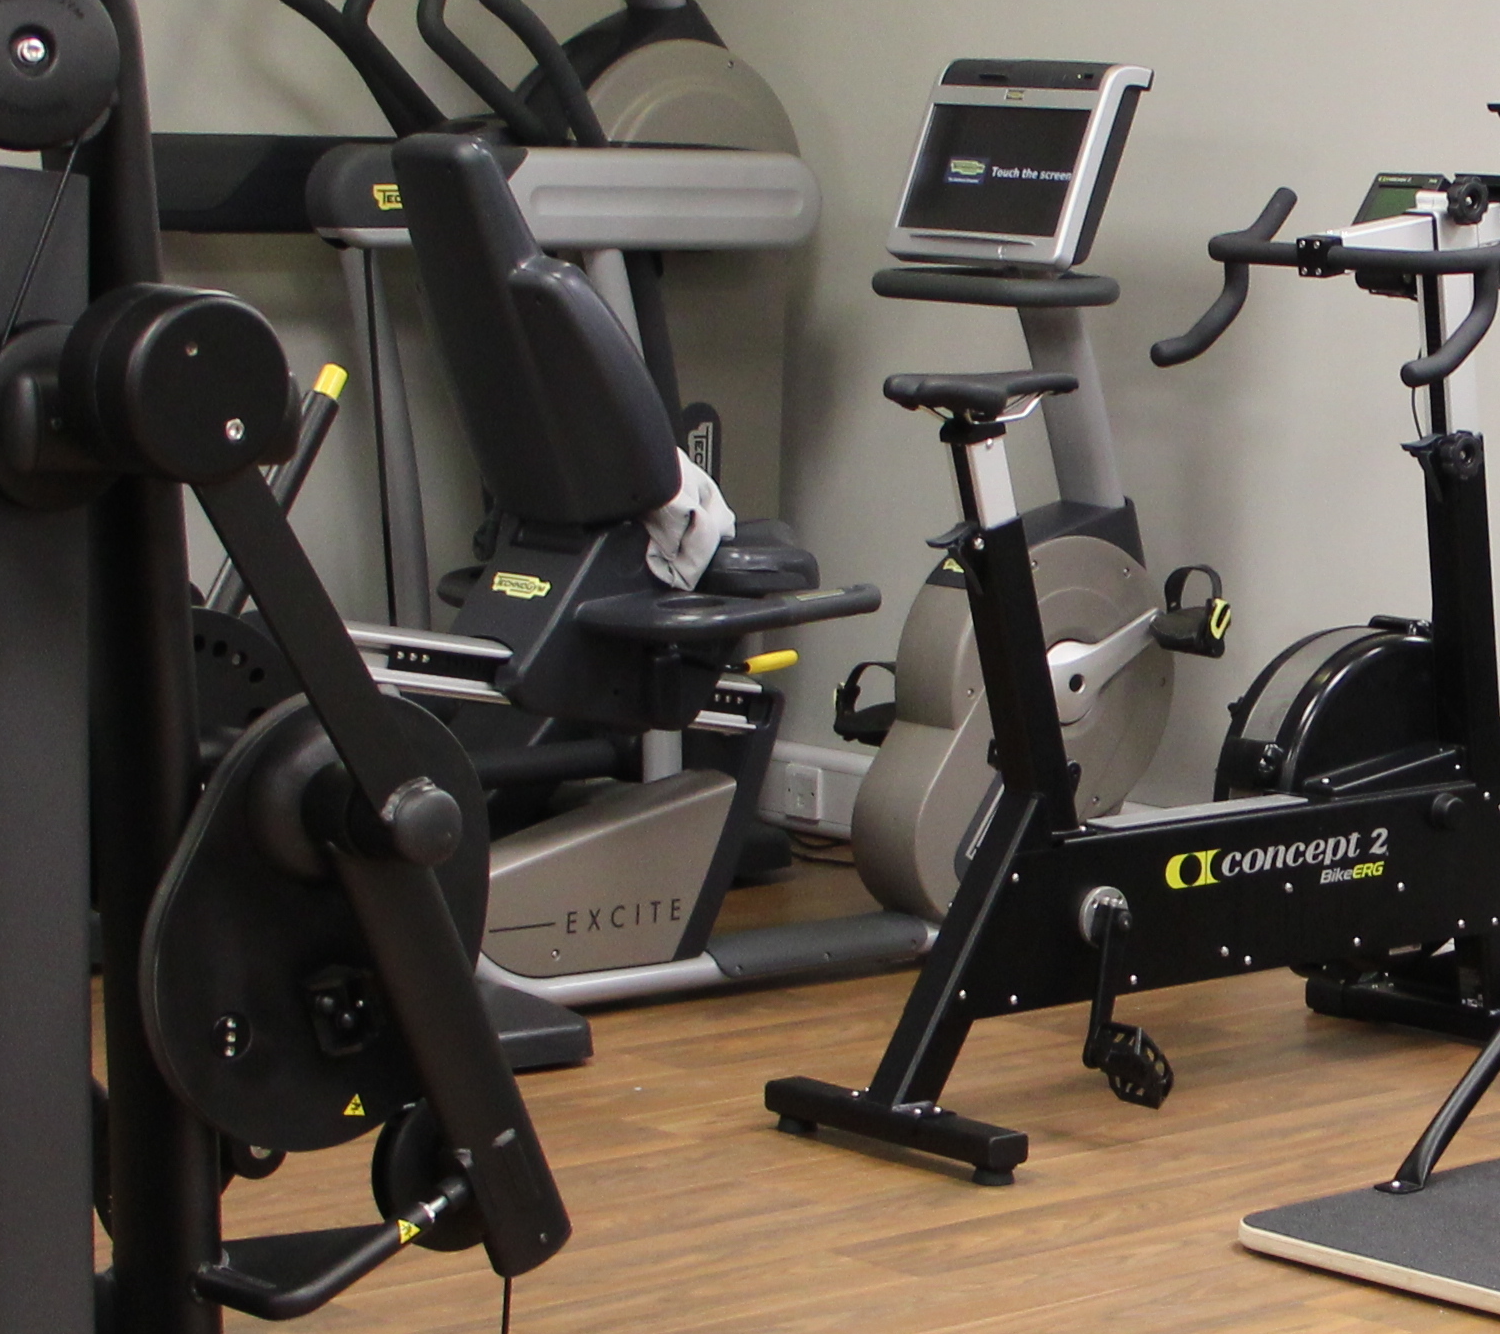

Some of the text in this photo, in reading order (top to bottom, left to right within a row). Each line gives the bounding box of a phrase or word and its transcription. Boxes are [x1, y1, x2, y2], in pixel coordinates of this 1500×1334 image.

[991, 166, 1020, 178] Touch
[1022, 168, 1038, 180] the
[1040, 170, 1072, 181] screen
[1221, 827, 1389, 877] concept 2
[1320, 861, 1385, 884] BikeERG
[566, 898, 681, 934] EXCITE
